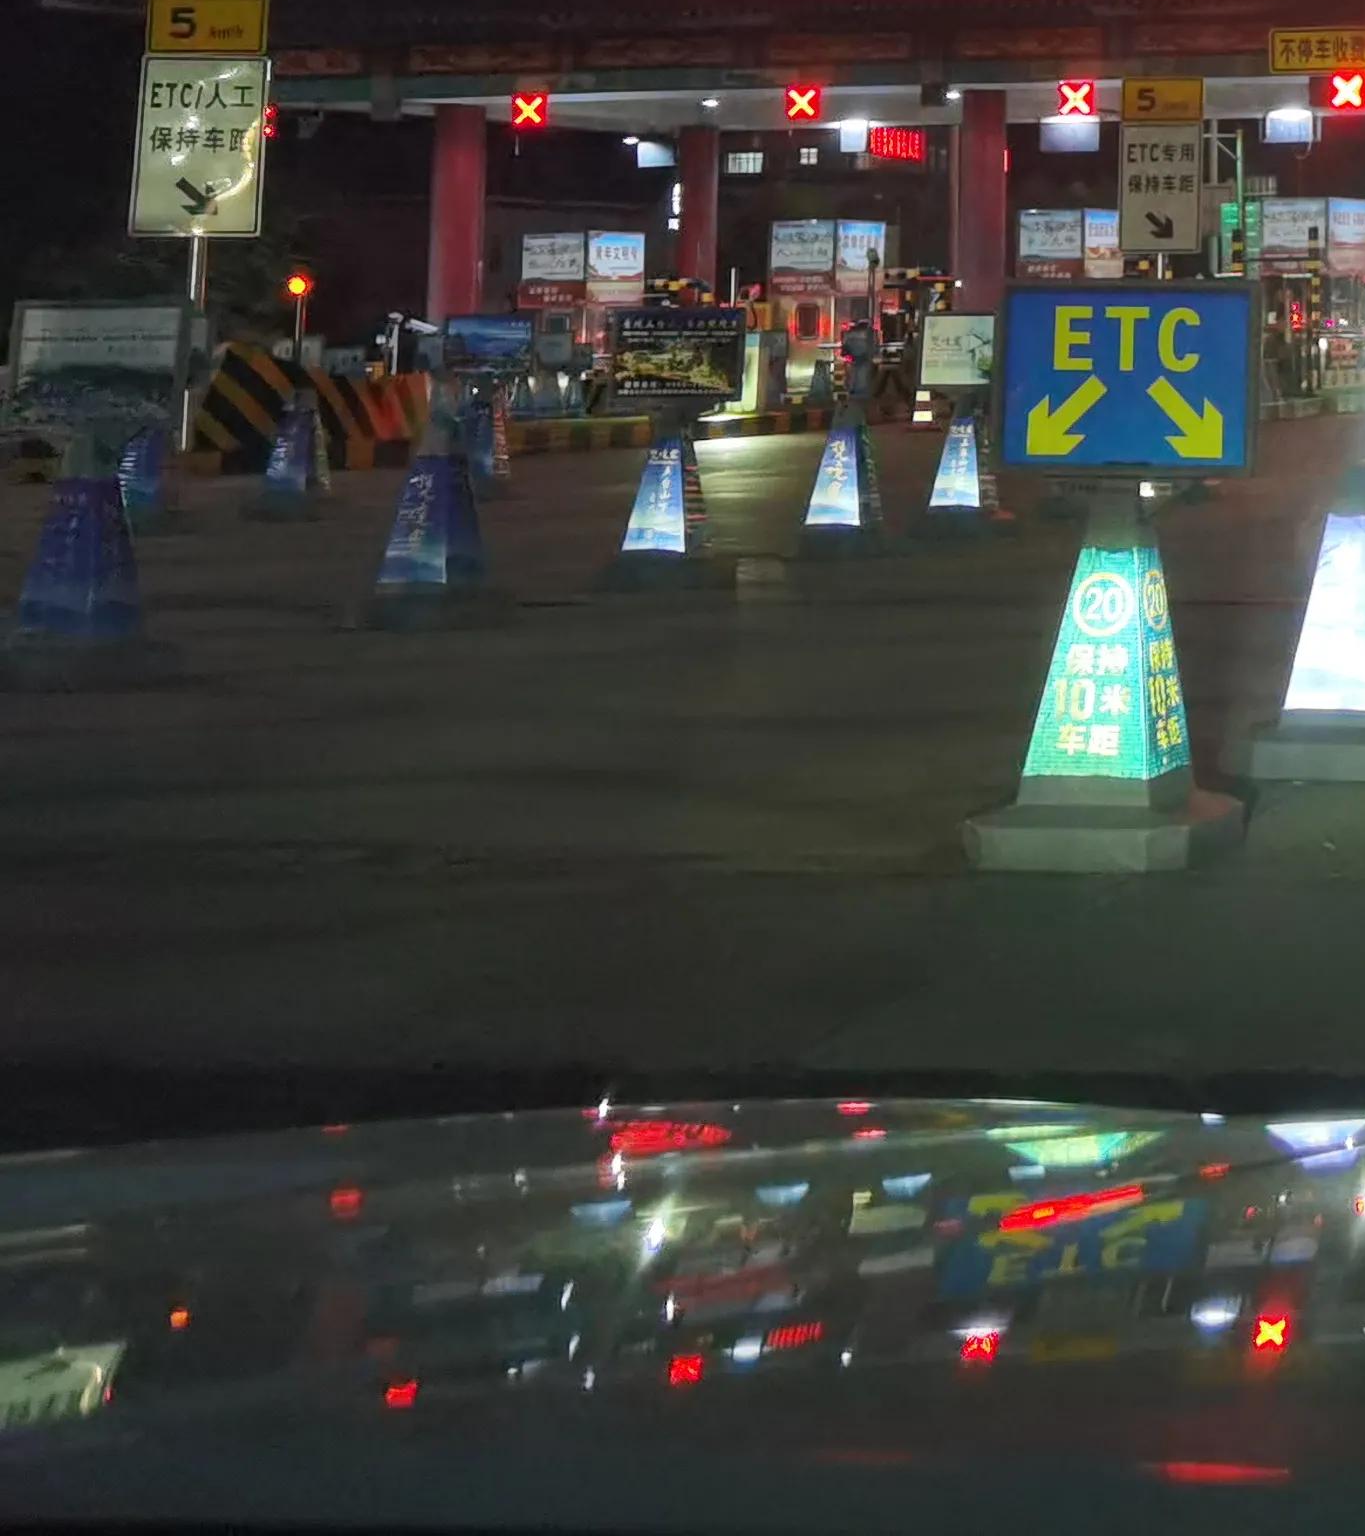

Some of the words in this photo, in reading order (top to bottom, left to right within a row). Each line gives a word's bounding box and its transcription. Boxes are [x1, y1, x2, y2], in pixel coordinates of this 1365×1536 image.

[169, 7, 197, 39] 5
[150, 81, 255, 110] ETC/人工
[1136, 88, 1157, 112] 5
[1127, 142, 1196, 164] ETC专用
[1127, 174, 1195, 196] 保持车距
[1052, 304, 1201, 373] ETC
[1086, 586, 1124, 620] 20
[1054, 677, 1131, 721] 10米
